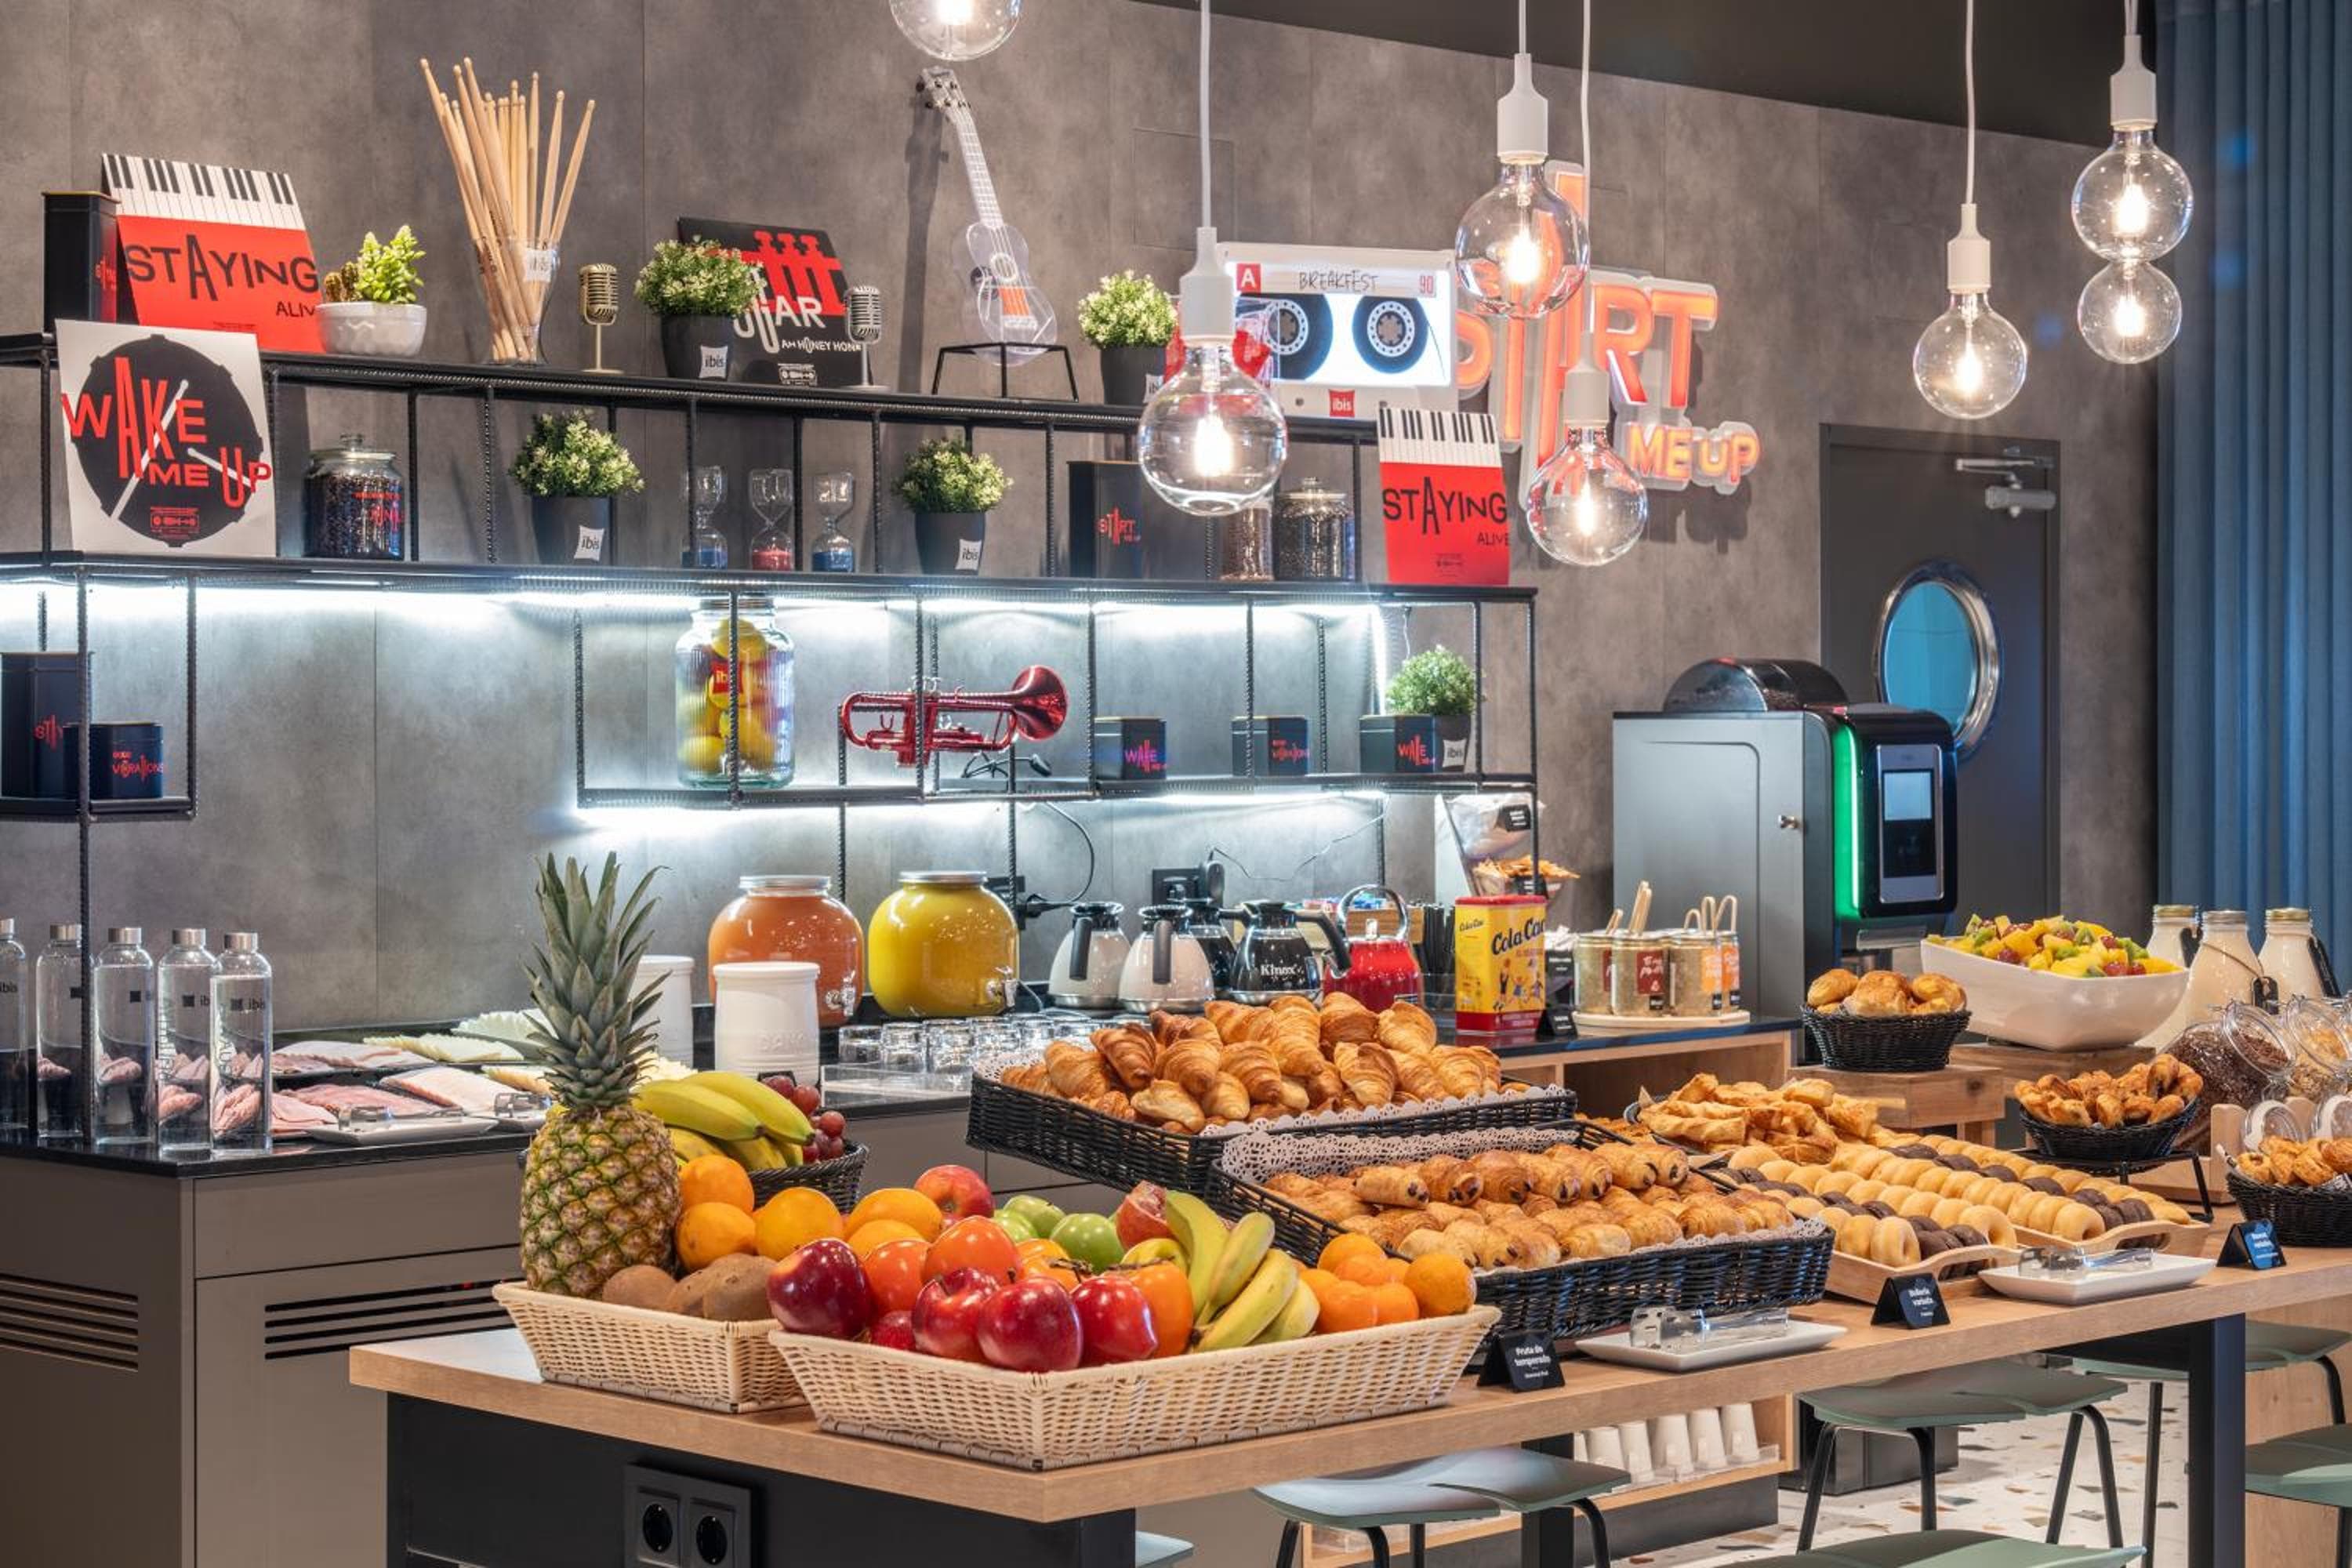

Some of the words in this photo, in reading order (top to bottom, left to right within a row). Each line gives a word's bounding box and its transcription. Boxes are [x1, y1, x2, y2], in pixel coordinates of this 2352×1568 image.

[125, 234, 319, 301] STAYING
[1240, 268, 1257, 288] A
[1419, 275, 1434, 295] 90
[275, 301, 316, 318] ALIV
[705, 356, 725, 368] ibis
[1332, 397, 1352, 412] ibis
[61, 357, 208, 480] WAKE
[1627, 424, 1693, 481] ME
[1700, 433, 1760, 484] UP
[148, 463, 209, 488] ME
[220, 447, 272, 508] UP
[1381, 476, 1508, 535] STAYING
[1477, 532, 1510, 546] ALIVE
[961, 546, 979, 560] ibis
